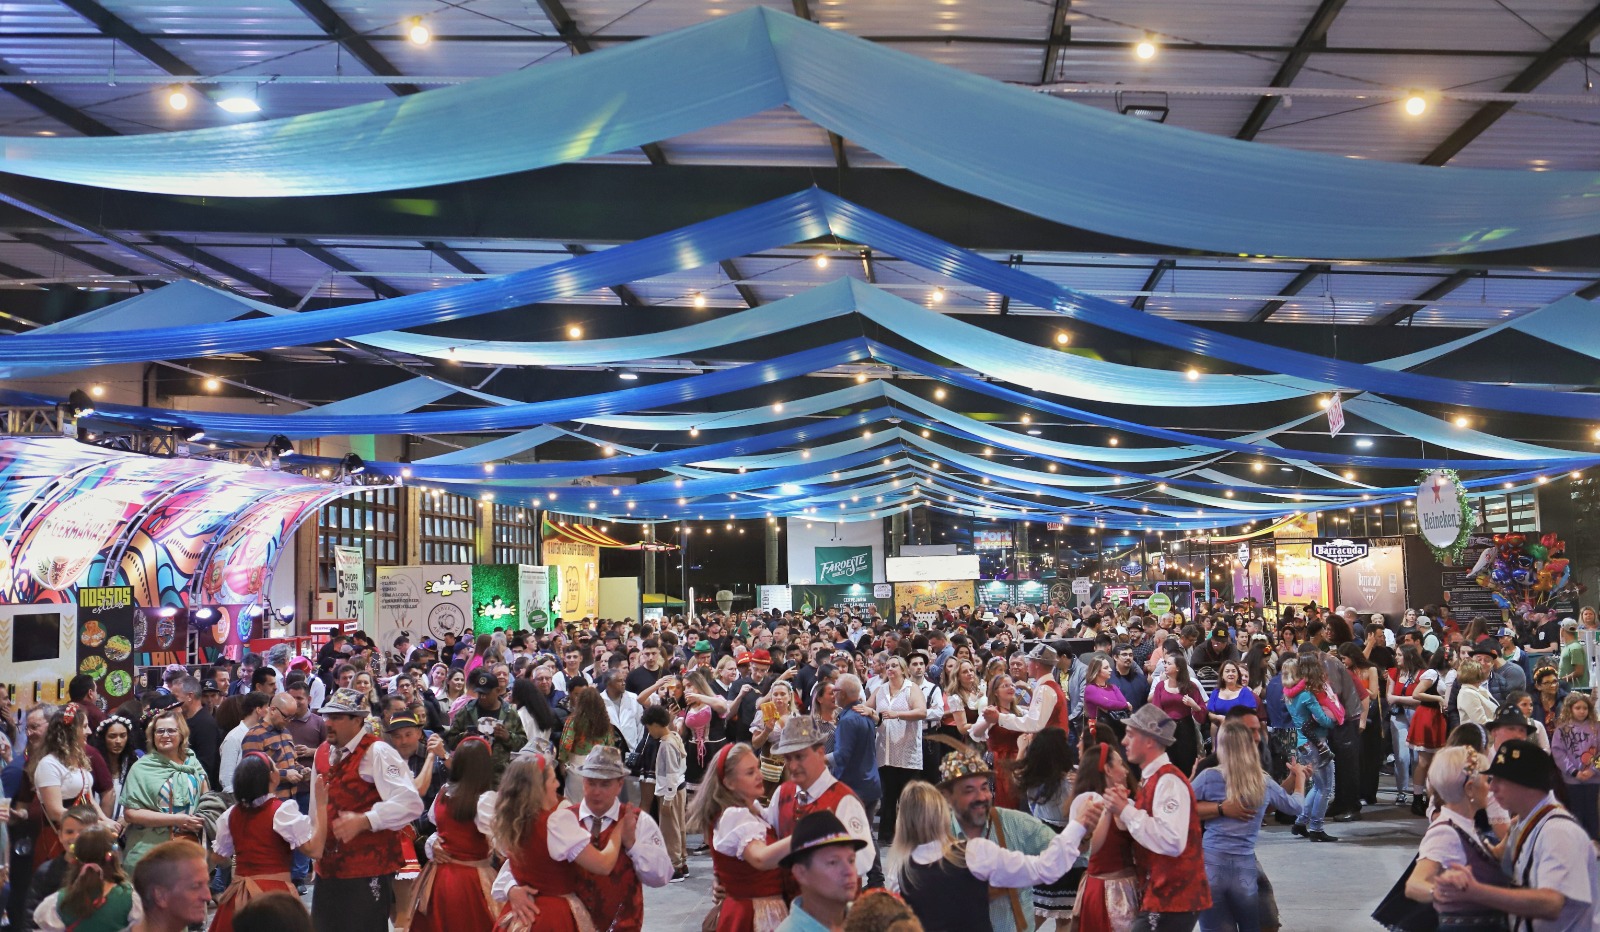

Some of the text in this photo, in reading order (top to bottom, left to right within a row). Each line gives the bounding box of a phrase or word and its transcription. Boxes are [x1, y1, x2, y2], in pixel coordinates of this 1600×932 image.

[1423, 511, 1458, 530] Heineken
[1318, 545, 1363, 555] Barracuda
[820, 553, 868, 581] FAROESTE
[339, 570, 344, 598] 5
[80, 587, 131, 607] NOSSOS
